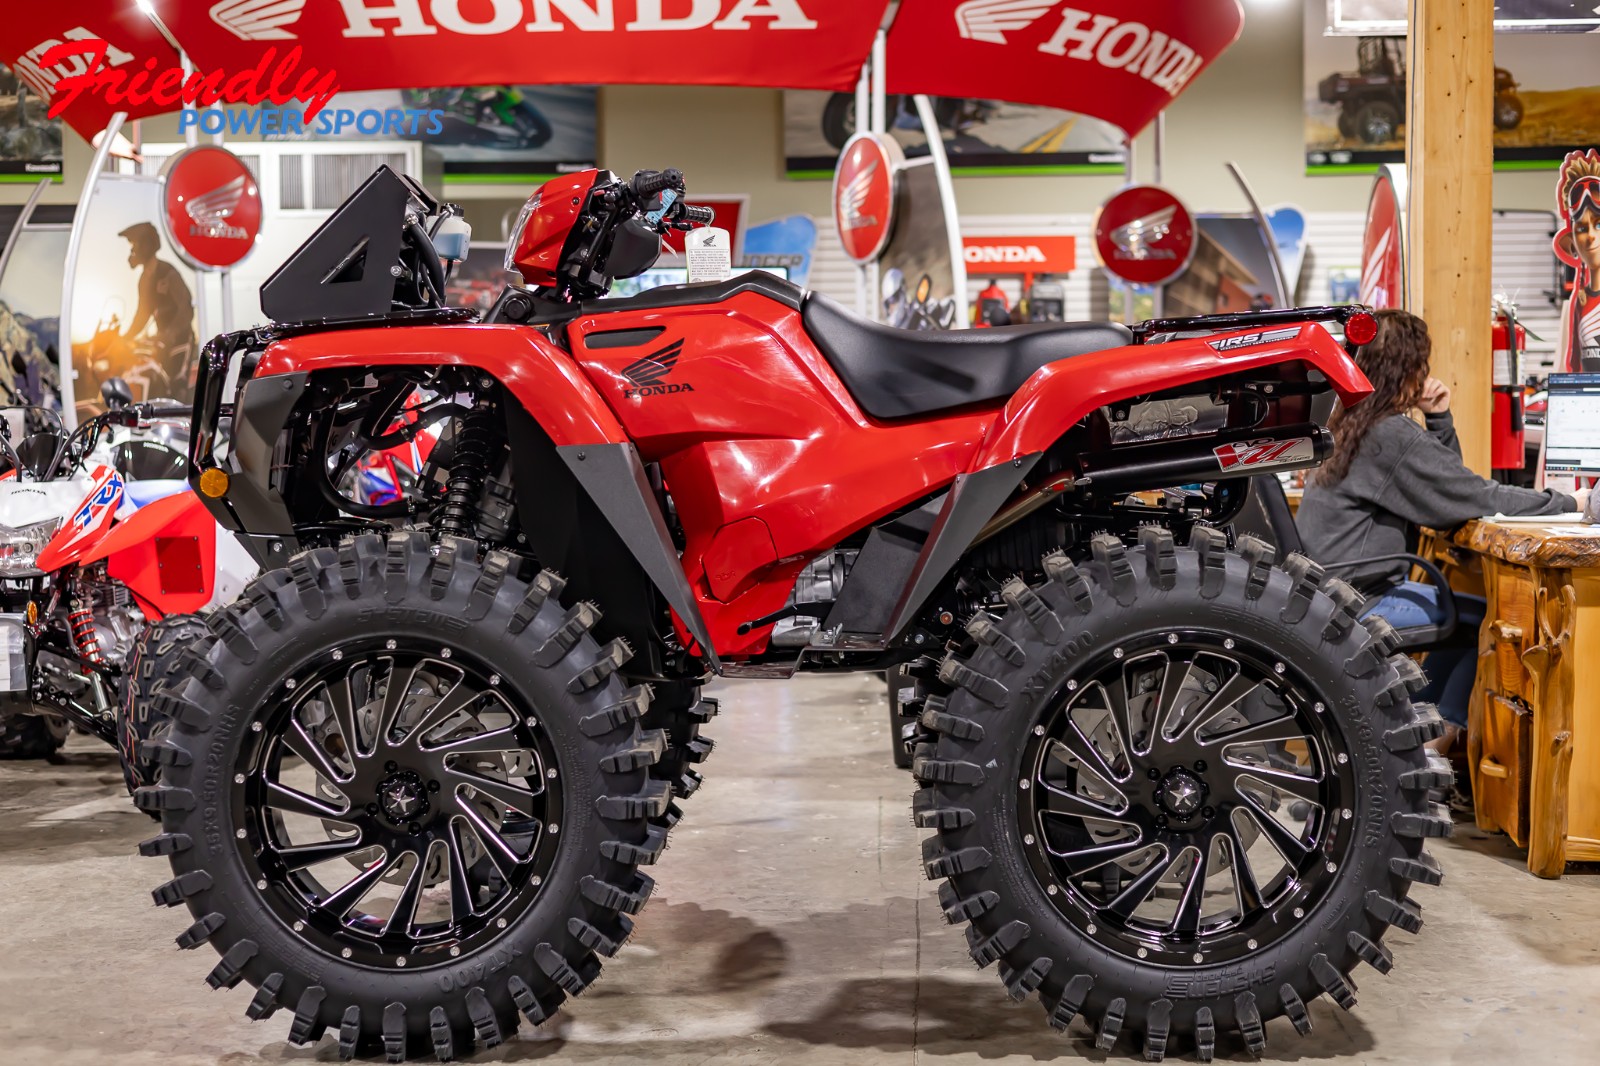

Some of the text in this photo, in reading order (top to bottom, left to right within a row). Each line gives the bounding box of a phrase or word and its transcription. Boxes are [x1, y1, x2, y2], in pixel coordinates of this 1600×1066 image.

[341, 0, 818, 39] HONDA
[189, 226, 249, 240] HONDA
[963, 245, 1047, 263] ONDA
[1219, 332, 1262, 348] IRS
[1582, 347, 1600, 359] HOND
[624, 383, 694, 398] HONDA
[11, 488, 47, 496] HONDA
[74, 473, 124, 528] TRX
[1019, 629, 1095, 702] XT400
[437, 943, 522, 994] XT400
